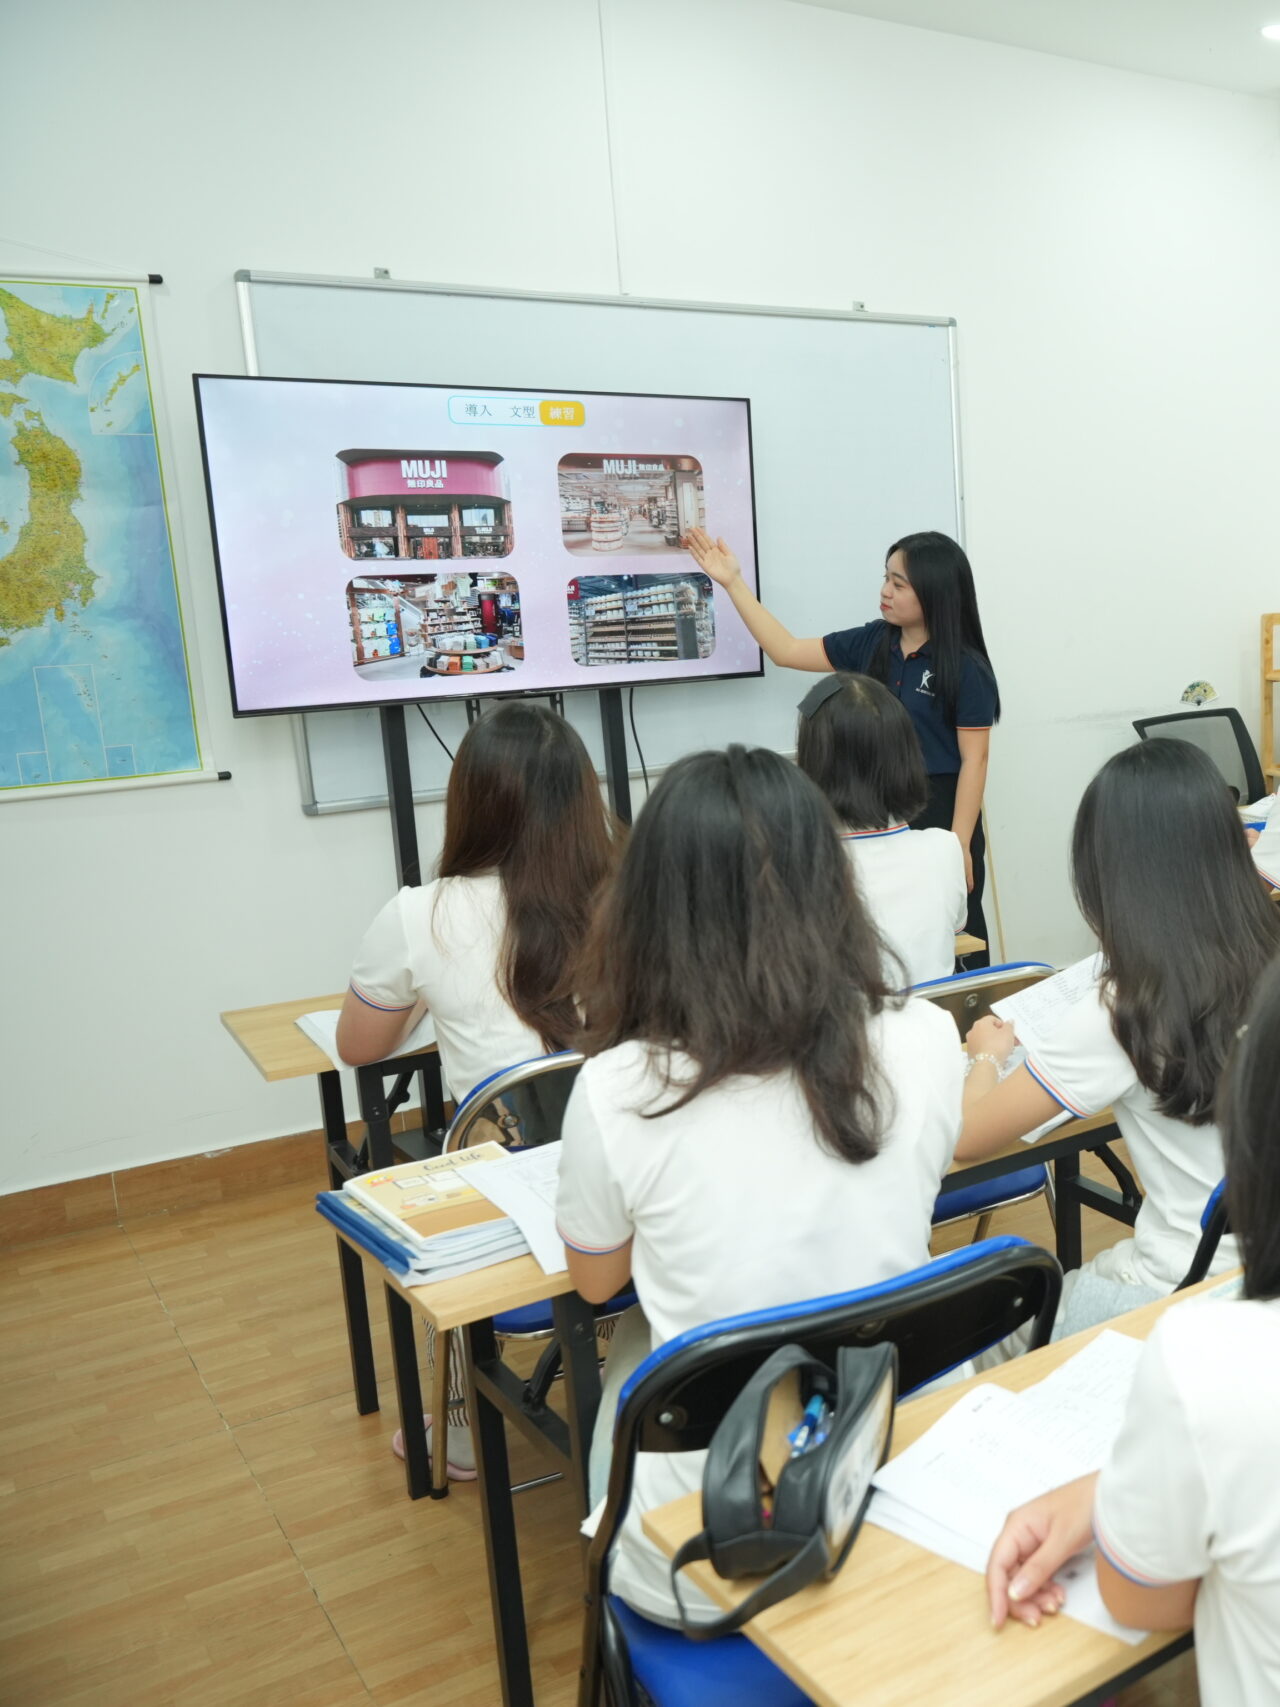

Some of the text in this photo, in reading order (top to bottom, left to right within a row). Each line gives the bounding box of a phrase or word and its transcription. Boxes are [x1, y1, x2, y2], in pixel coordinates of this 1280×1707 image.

[465, 403, 493, 417] 導入
[510, 405, 536, 419] 文型
[401, 459, 448, 478] MUJI
[603, 459, 637, 475] MUJI
